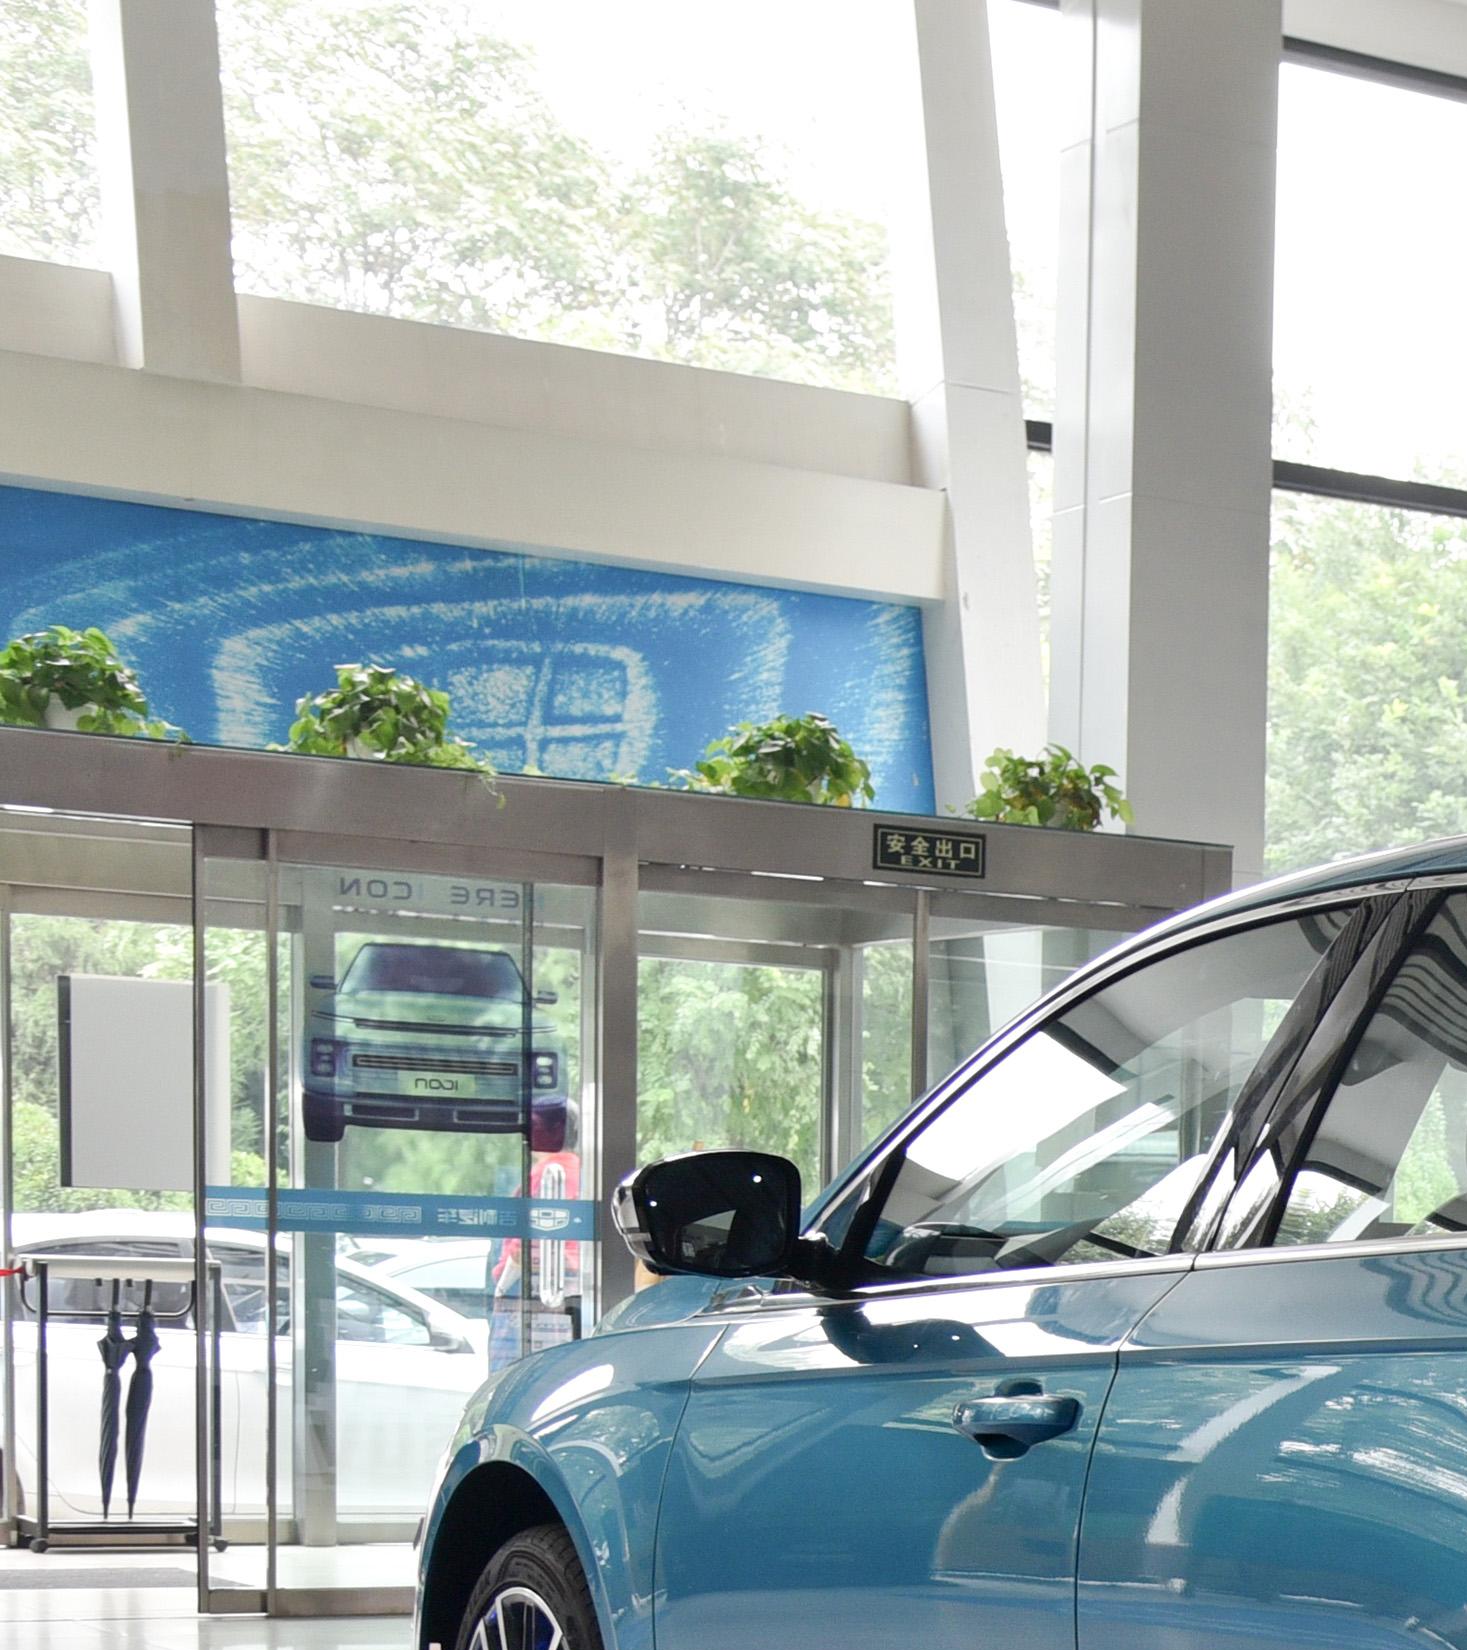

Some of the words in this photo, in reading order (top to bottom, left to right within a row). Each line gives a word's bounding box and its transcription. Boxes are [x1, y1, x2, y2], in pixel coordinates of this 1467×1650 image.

[886, 833, 976, 859] 安全出口
[901, 855, 960, 870] EXIT
